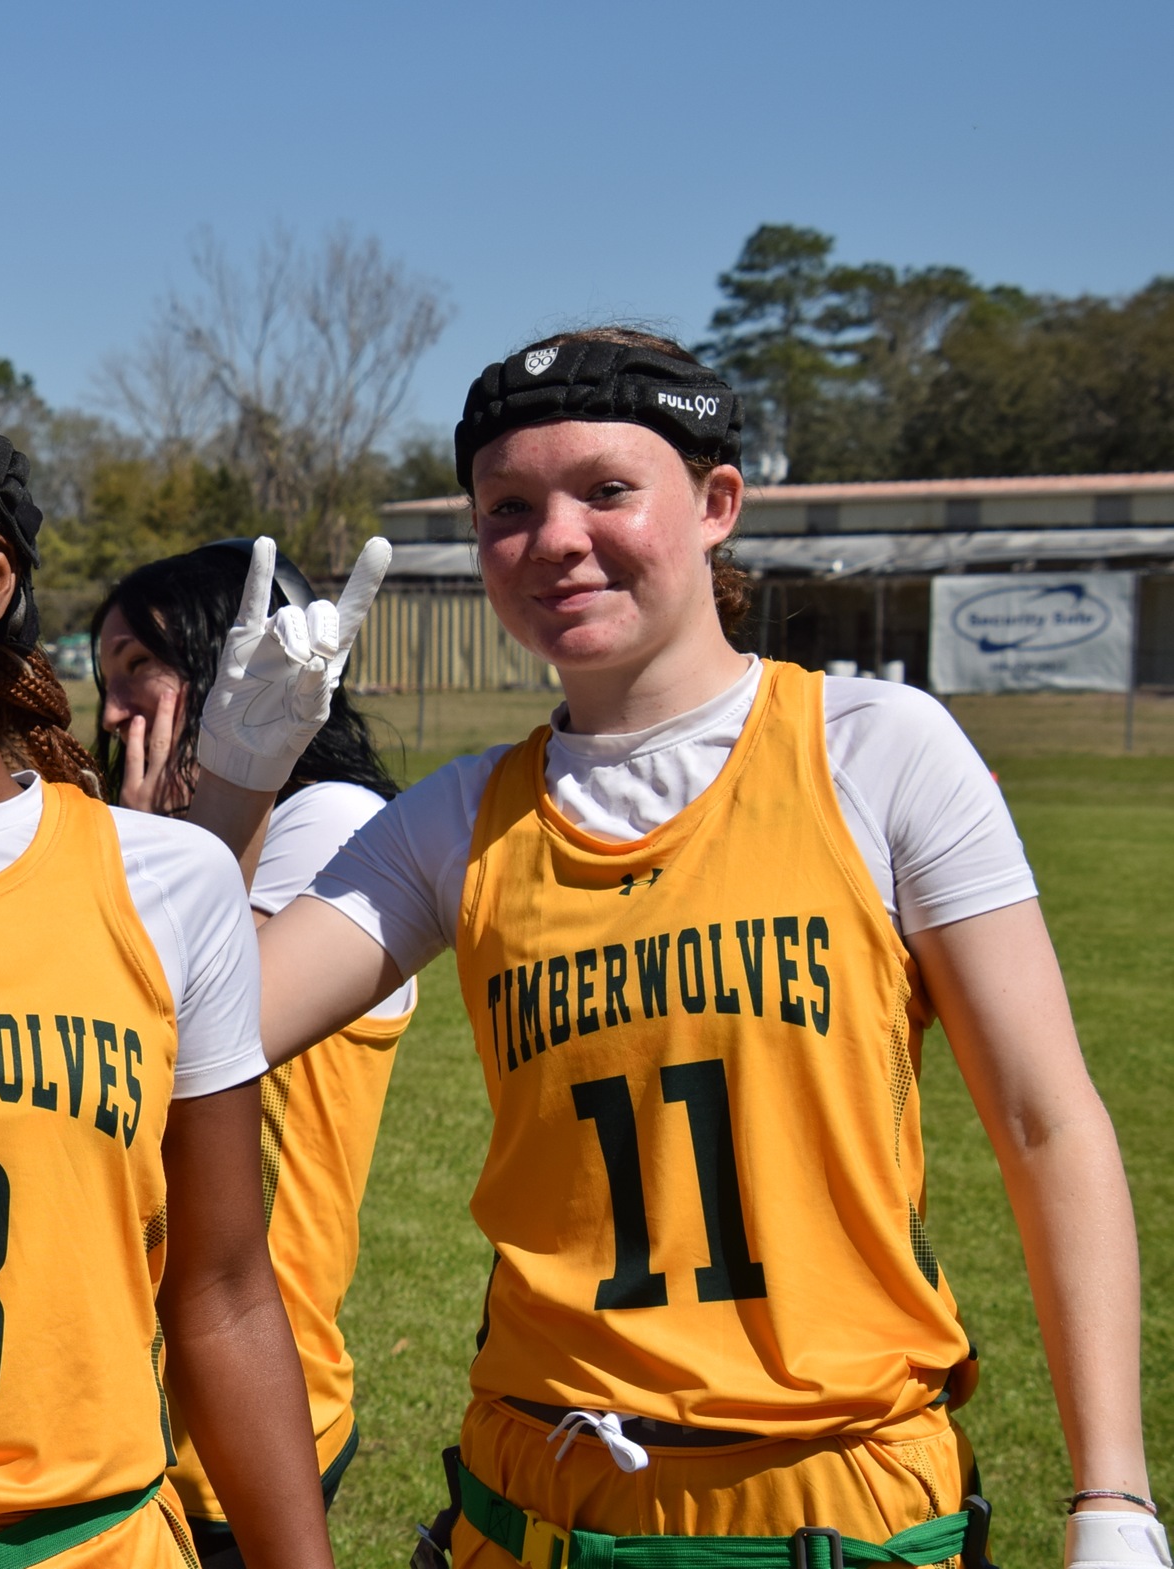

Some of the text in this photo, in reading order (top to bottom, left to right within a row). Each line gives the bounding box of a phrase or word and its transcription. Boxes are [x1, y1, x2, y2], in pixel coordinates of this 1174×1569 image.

[529, 355, 553, 372] 90
[487, 916, 831, 1081] TIMBERWOLVES
[570, 1058, 768, 1311] 11
